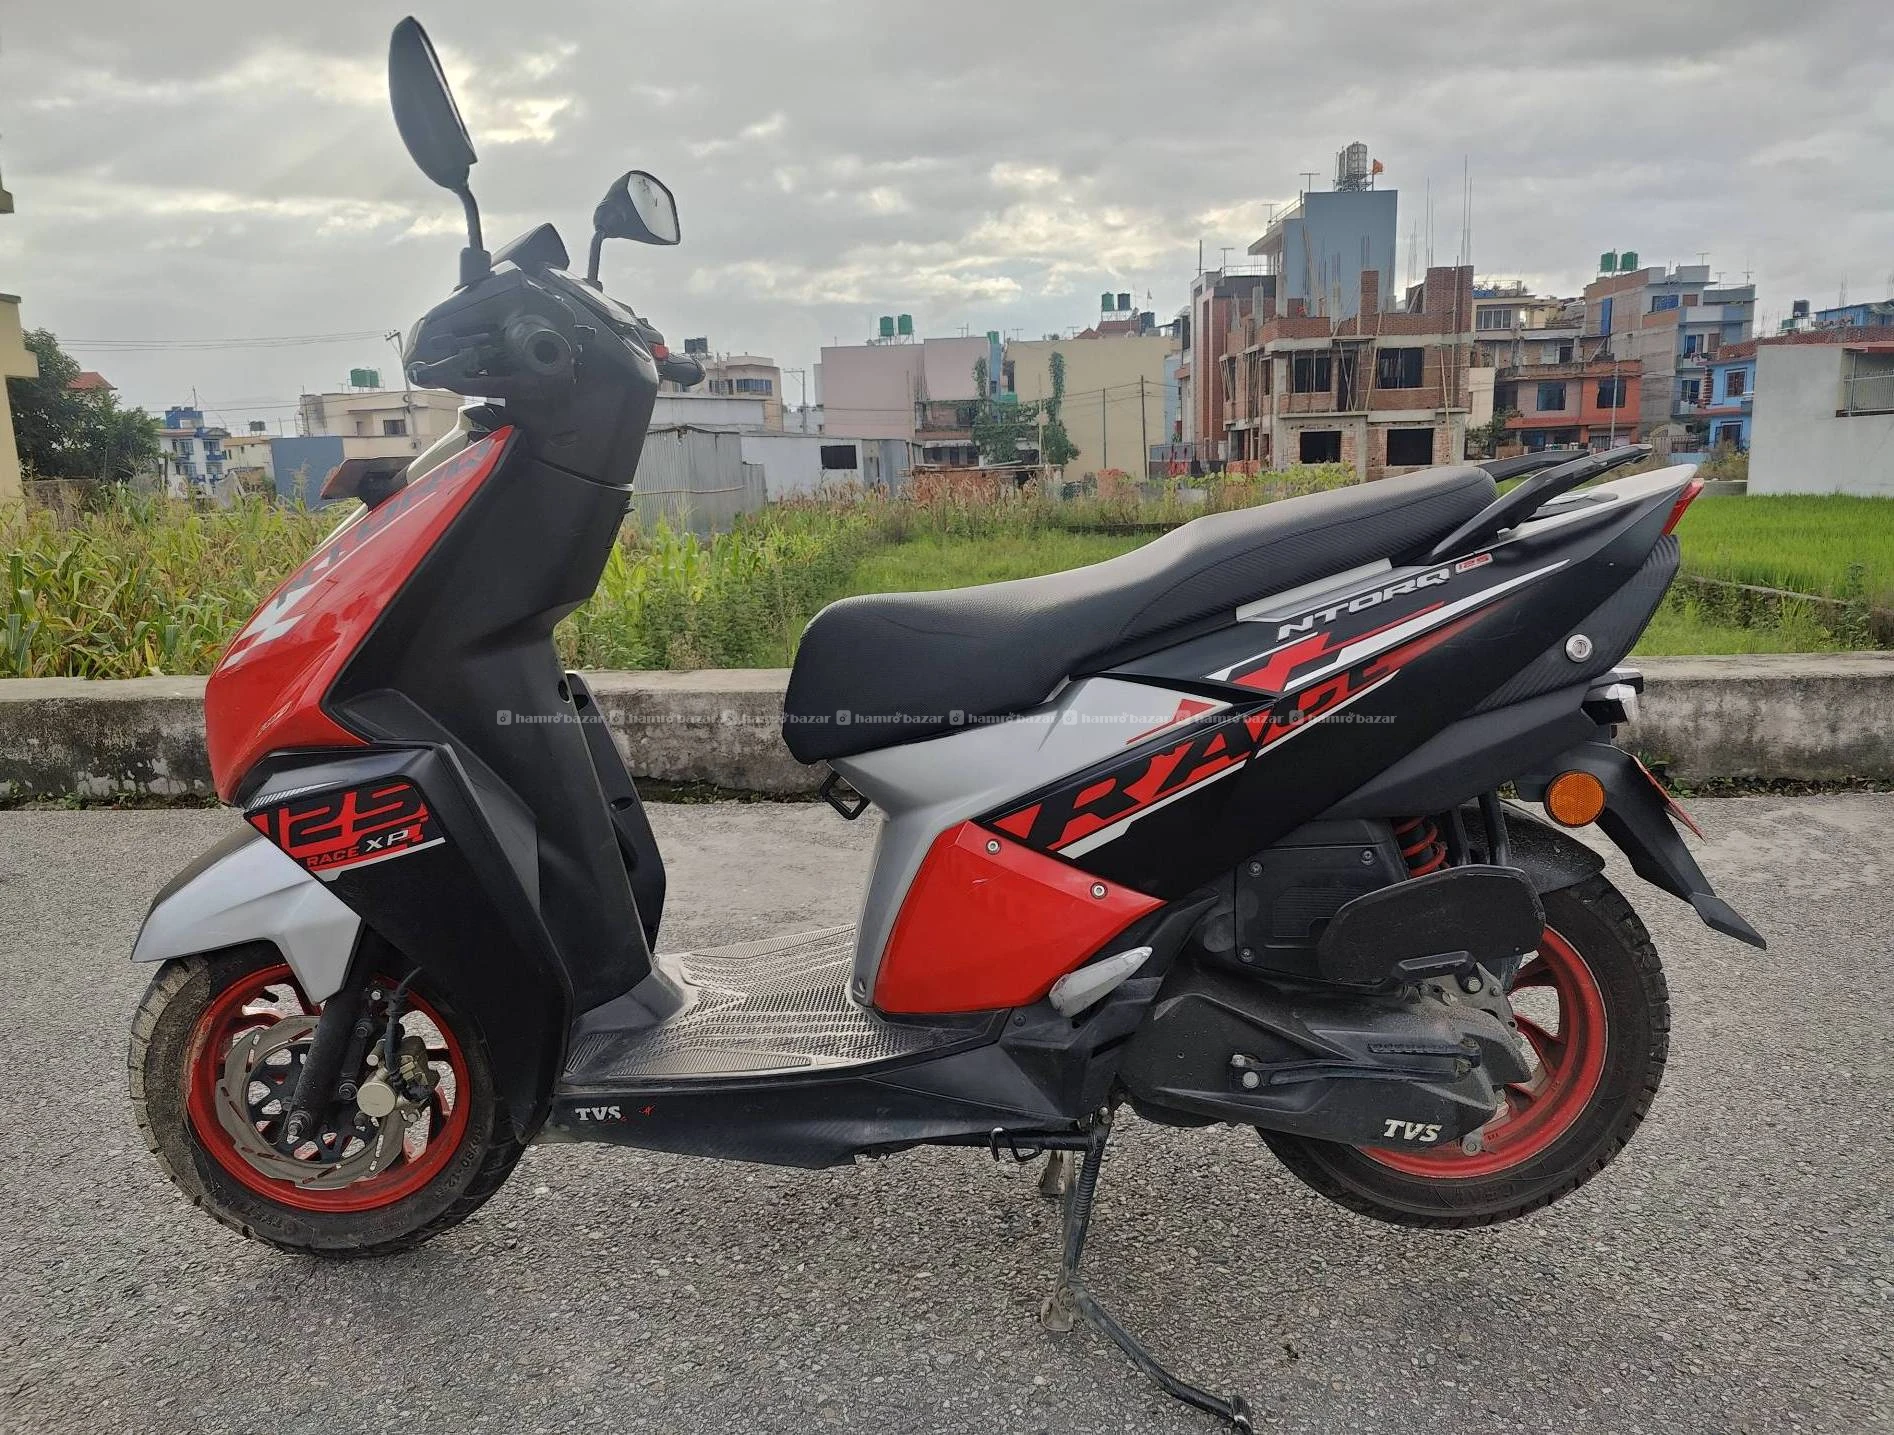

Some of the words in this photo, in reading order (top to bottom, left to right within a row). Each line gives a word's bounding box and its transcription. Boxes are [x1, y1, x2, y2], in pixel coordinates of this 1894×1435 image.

[1276, 567, 1450, 642] NTORQ
[252, 780, 427, 856] 125
[305, 847, 360, 868] RACE
[365, 829, 409, 852] XP
[574, 1105, 622, 1121] TVS
[1383, 1118, 1443, 1142] TVS
